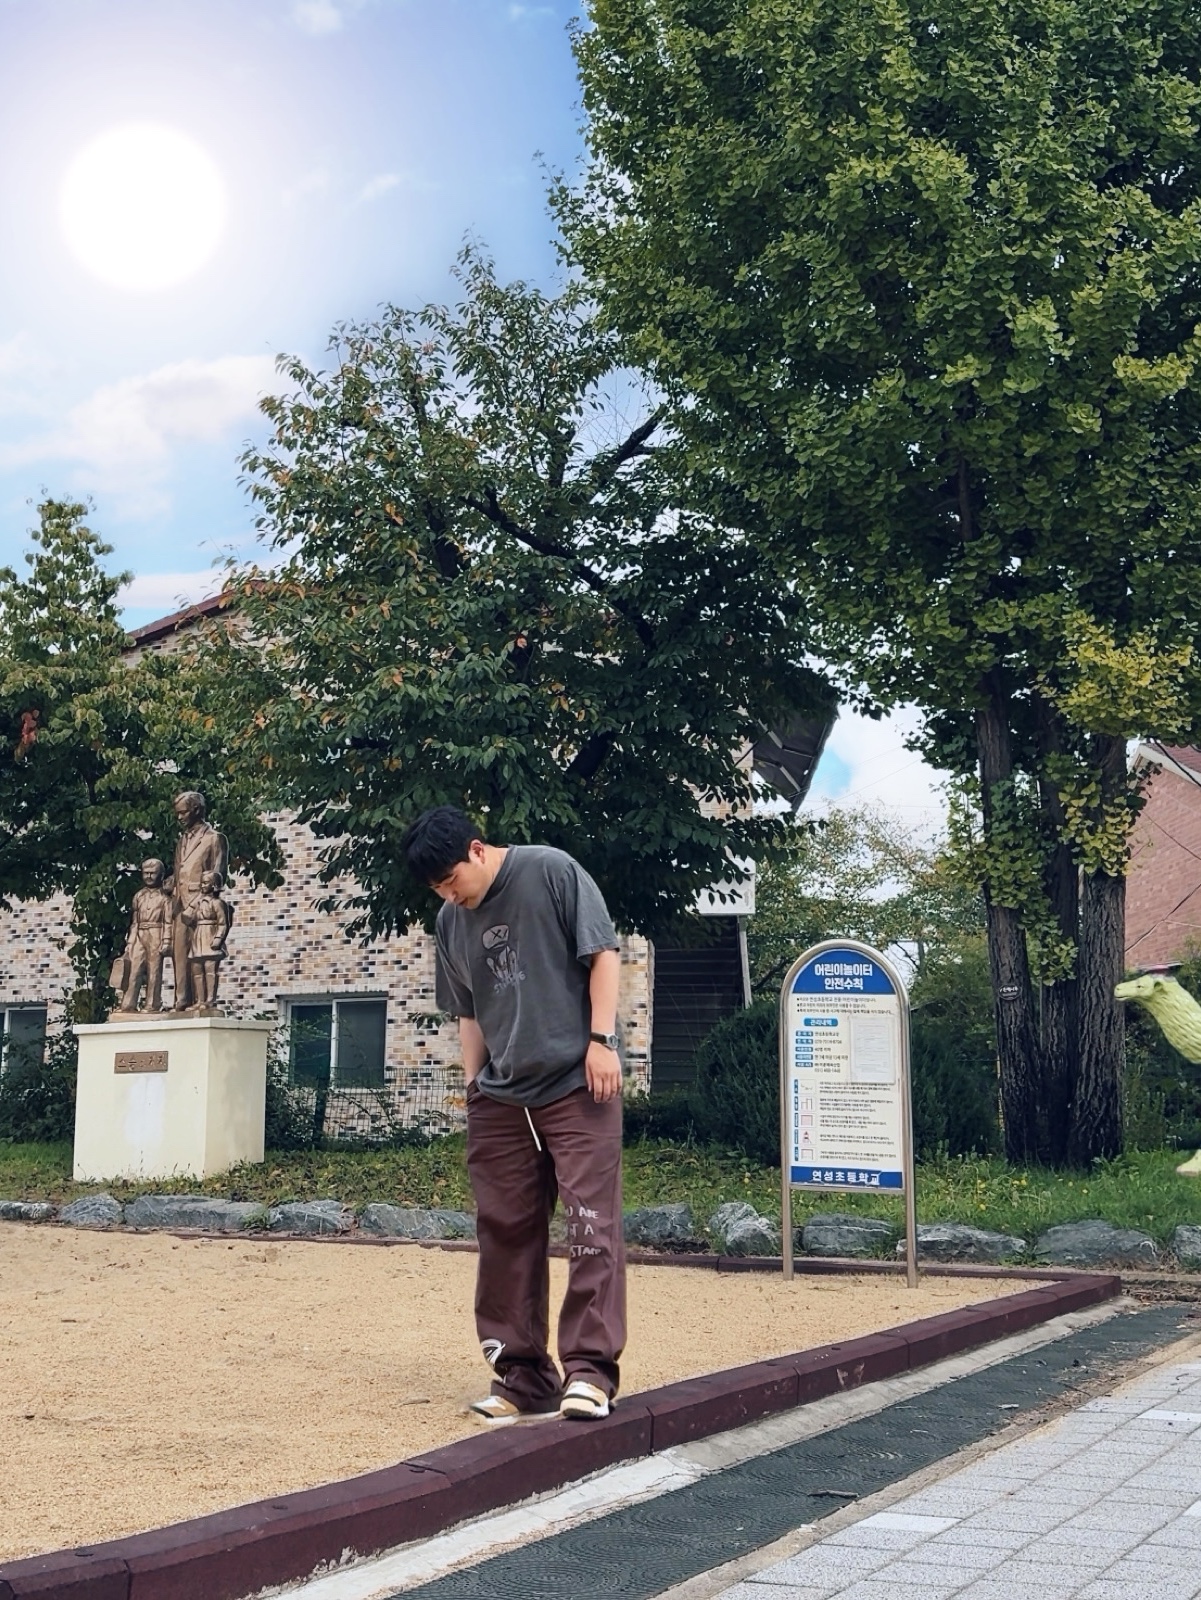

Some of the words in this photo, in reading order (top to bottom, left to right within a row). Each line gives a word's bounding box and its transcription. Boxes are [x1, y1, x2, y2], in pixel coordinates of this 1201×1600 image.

[814, 963, 873, 976] 어린이놀이터
[824, 977, 864, 990] 안전수칙
[812, 1170, 880, 1185] 연성초등학교
[584, 1223, 594, 1236] A
